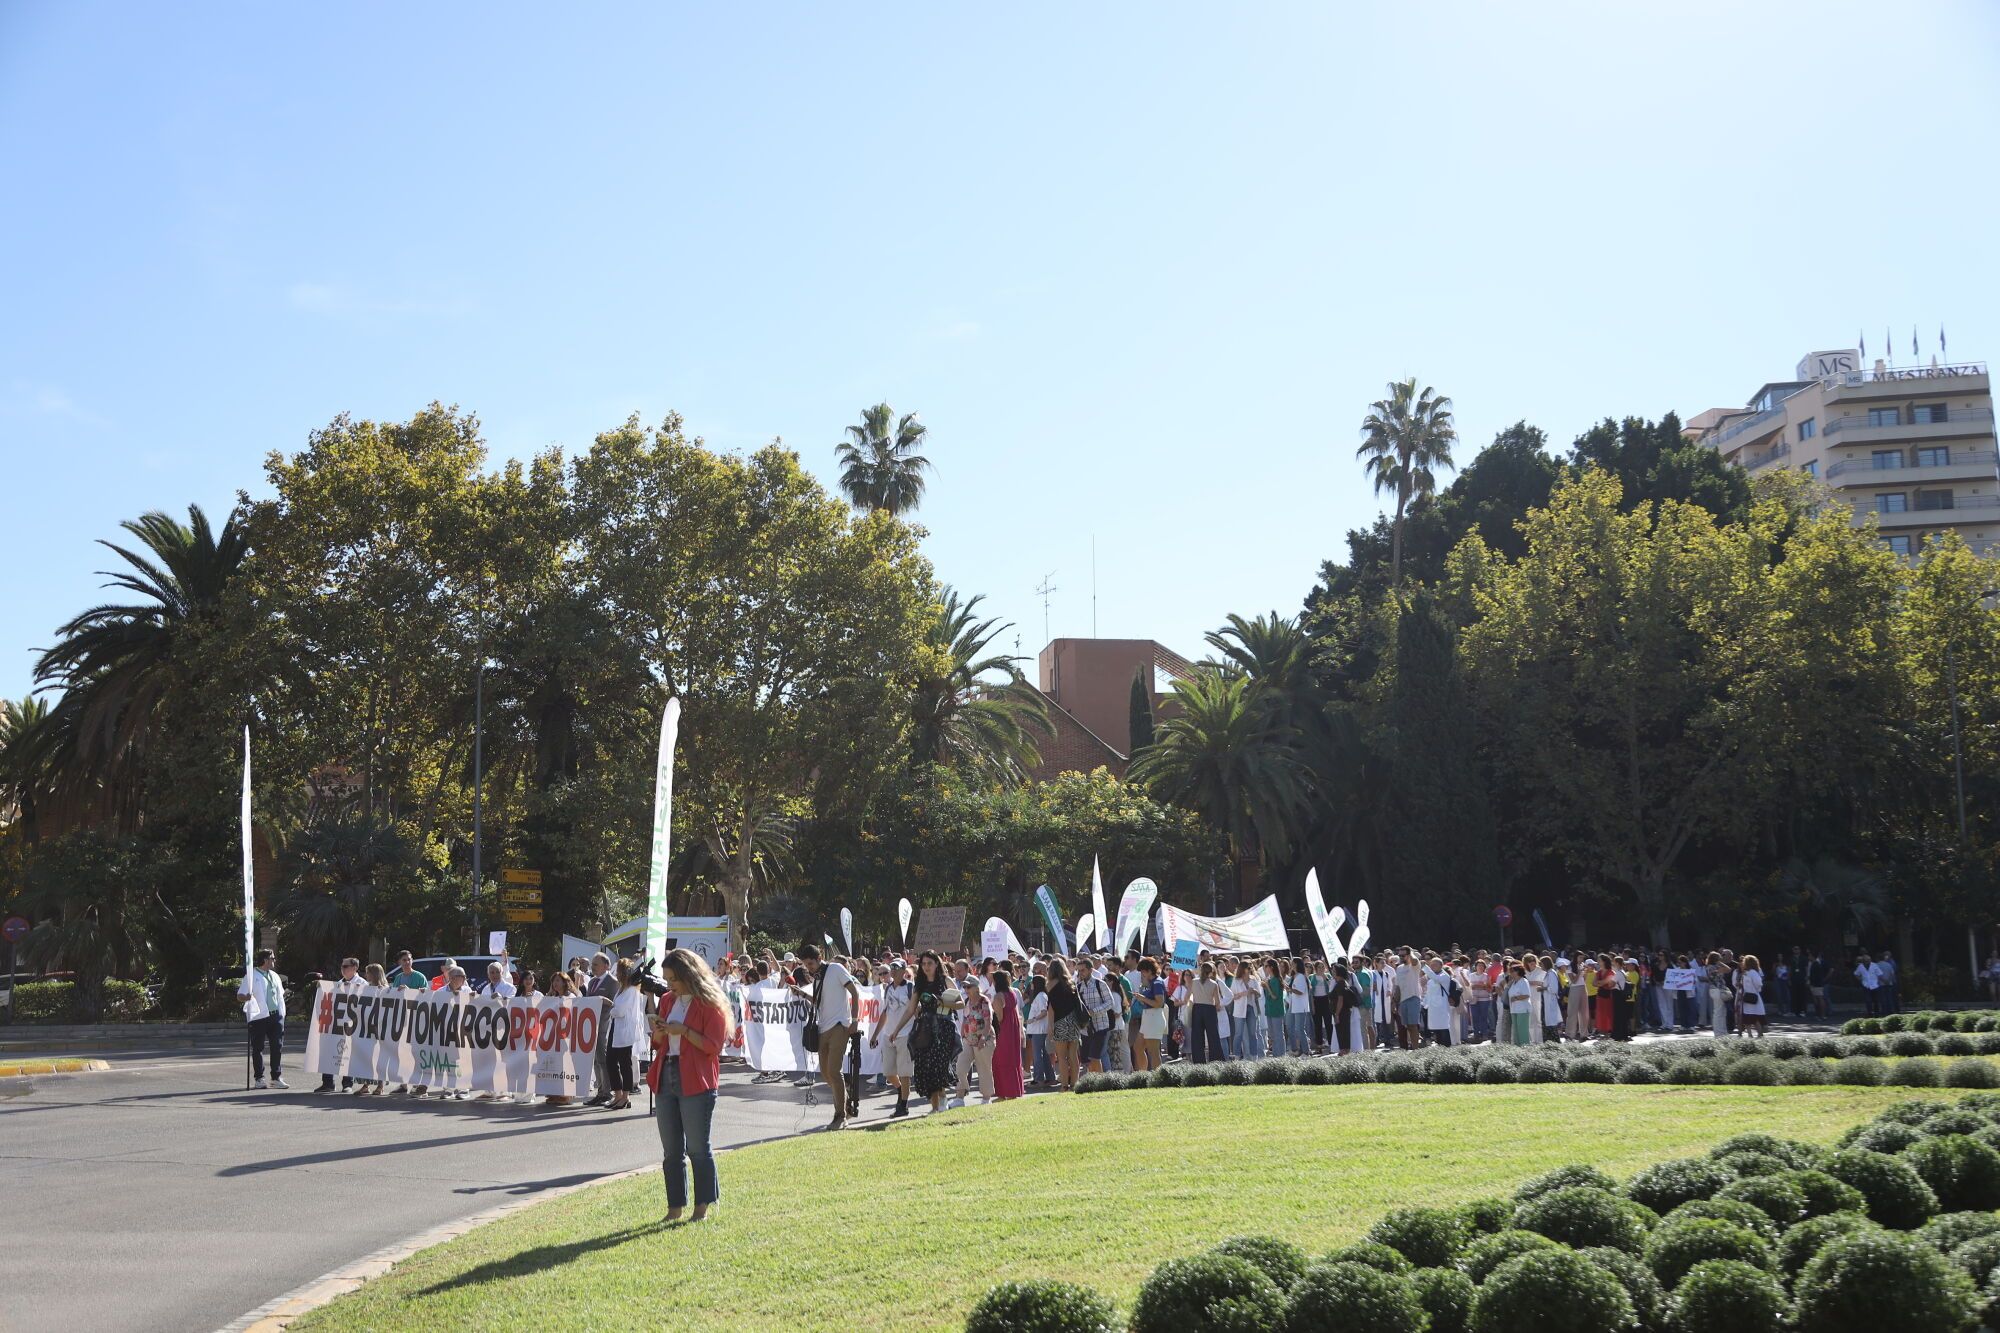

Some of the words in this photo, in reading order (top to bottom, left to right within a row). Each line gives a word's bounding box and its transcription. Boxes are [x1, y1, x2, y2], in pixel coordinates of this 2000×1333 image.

[1818, 357, 1853, 376] MS
[1873, 365, 1981, 381] MAESTRANZA
[1849, 376, 1861, 384] MS
[318, 991, 598, 1054] #ESTATUTOMARCOPROPIO
[420, 1050, 459, 1072] SMA
